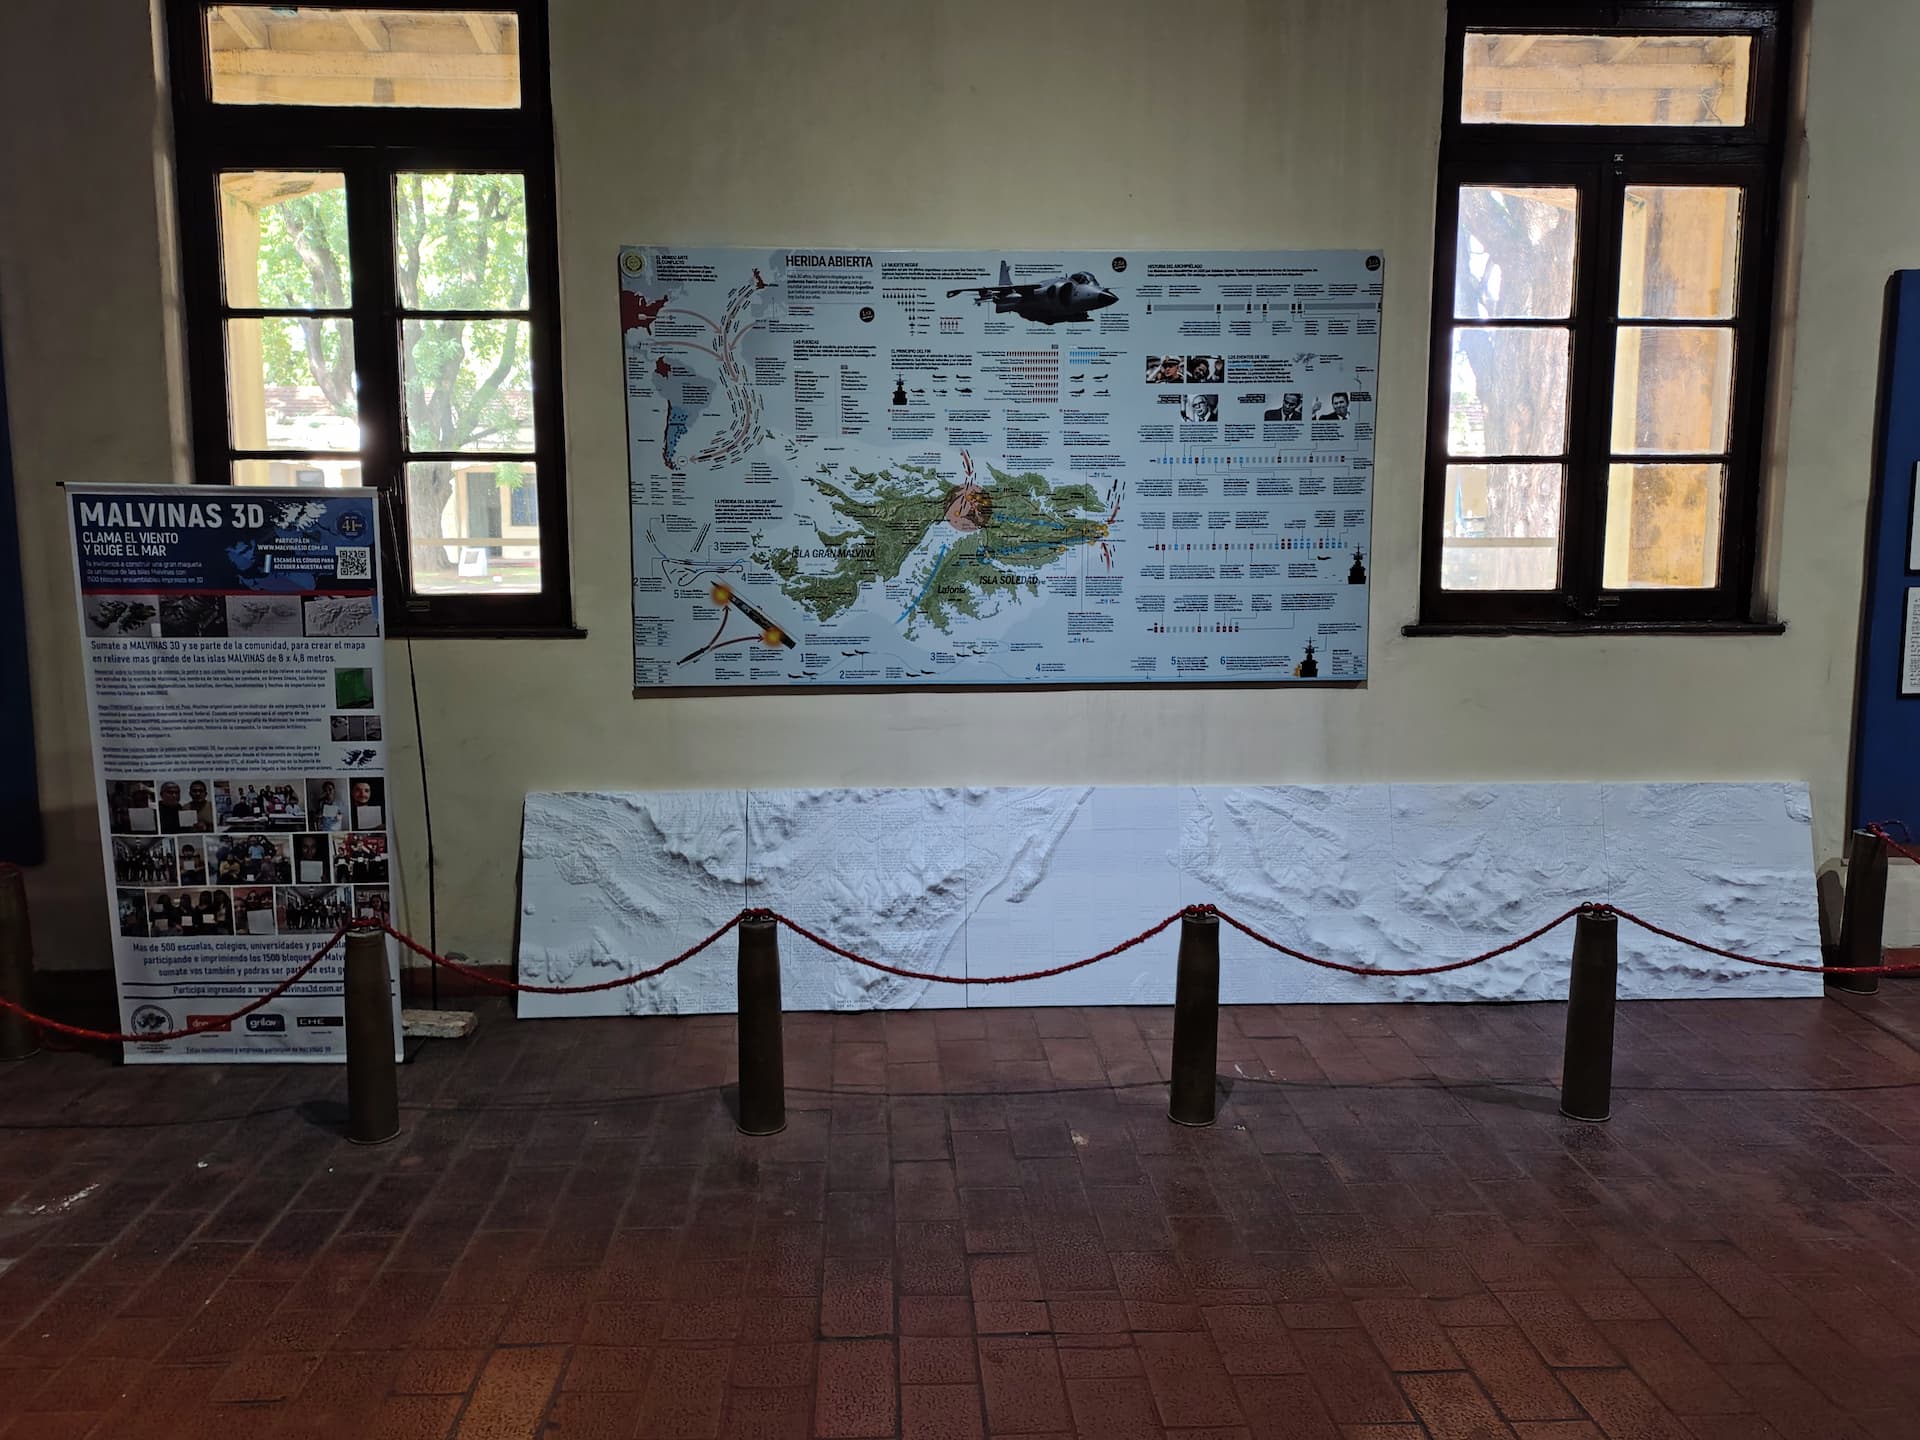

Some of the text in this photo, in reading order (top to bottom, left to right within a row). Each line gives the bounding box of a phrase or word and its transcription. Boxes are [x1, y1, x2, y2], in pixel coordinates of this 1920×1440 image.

[786, 256, 873, 267] HERIDA ABIERTA
[80, 502, 264, 528] MALVINAS 3D
[82, 532, 178, 544] CLAMA EL VIENTO
[84, 545, 166, 556] Y RUGE EL MAR
[714, 542, 719, 551] 3
[792, 549, 875, 558] ISLA GRAN MALVINA
[980, 576, 1038, 585] ISLA SOLEDAD
[938, 585, 966, 594] Lafonia
[674, 590, 679, 599] 5
[91, 640, 120, 650] Sumate
[130, 641, 168, 650] MALVINAS
[182, 643, 187, 652] y
[200, 641, 221, 651] parte
[224, 640, 233, 650] de
[235, 640, 243, 650] la
[244, 640, 288, 651] comunidad,
[291, 642, 309, 651] para
[335, 640, 342, 649] el
[344, 642, 365, 651] mapa
[104, 654, 130, 663] relieve
[152, 654, 179, 664] grande
[182, 654, 191, 662] de
[193, 654, 206, 662] las
[207, 653, 226, 662] islas
[267, 654, 276, 662] de
[293, 654, 304, 663] 4,8
[930, 652, 935, 661] 3
[1171, 656, 1176, 665] 5
[1220, 656, 1226, 665] 6
[839, 670, 844, 679] 2
[149, 943, 158, 952] de
[161, 943, 175, 951] 500
[178, 942, 214, 952] escuelas,
[216, 942, 248, 952] colegios,
[250, 942, 303, 950] universidades
[144, 955, 192, 965] participando
[201, 954, 248, 963] imprimiendo
[250, 953, 261, 962] los
[282, 954, 310, 963] bloques
[244, 966, 269, 976] podras
[286, 967, 304, 975] part
[173, 986, 205, 994] Participa
[207, 986, 246, 994] ingresando
